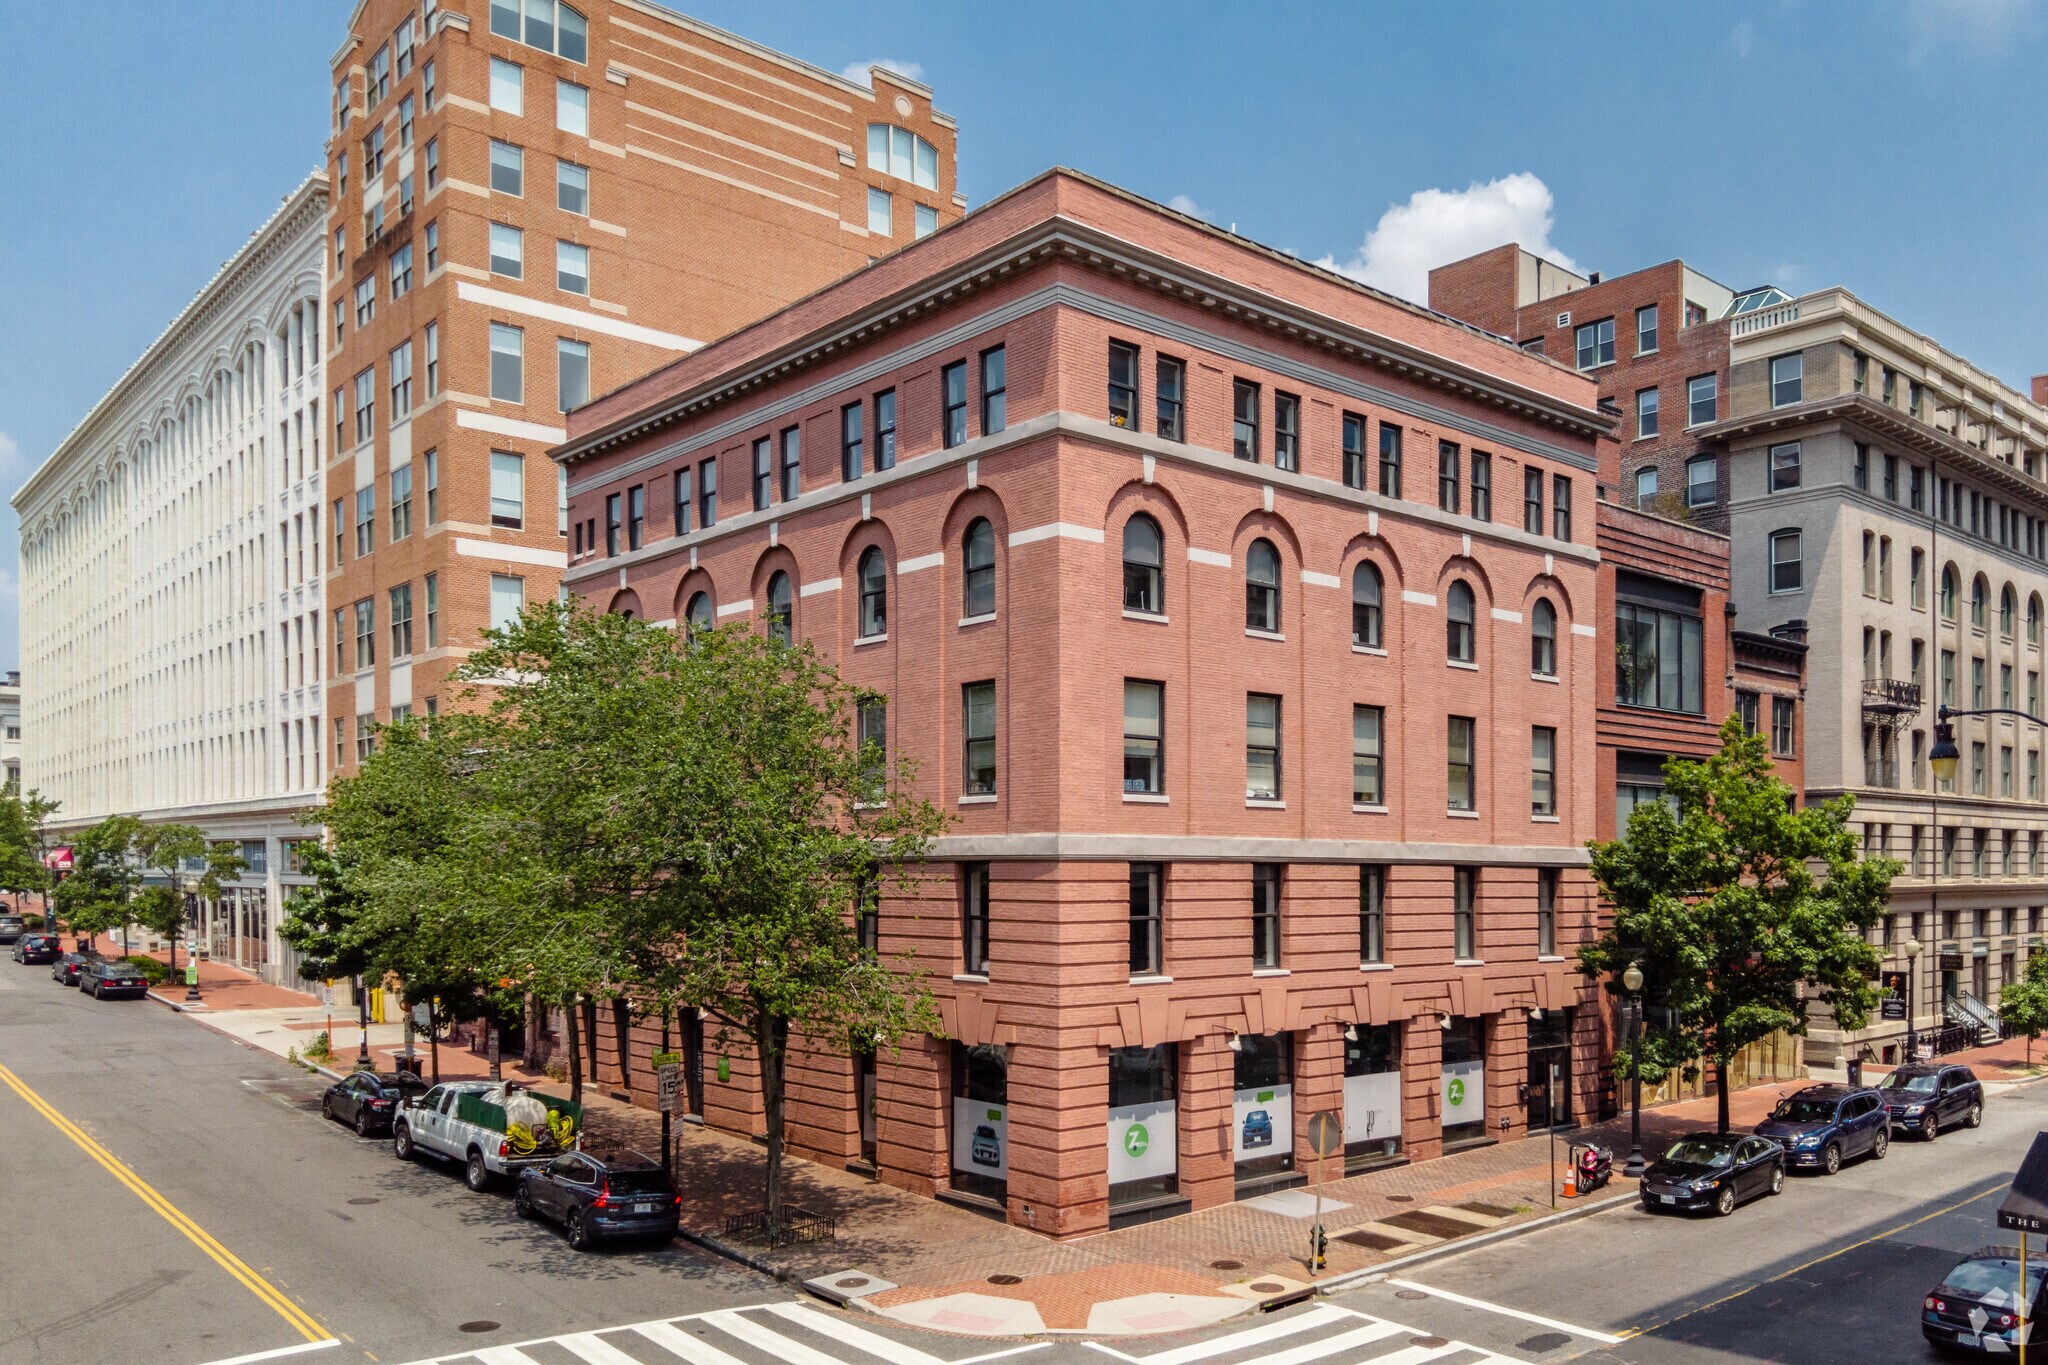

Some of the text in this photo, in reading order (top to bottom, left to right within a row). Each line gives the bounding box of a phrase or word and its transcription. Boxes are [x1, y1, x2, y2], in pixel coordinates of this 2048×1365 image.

[660, 1066, 678, 1074] SPEED
[662, 1081, 676, 1095] 15
[2005, 1215, 2040, 1229] THE
